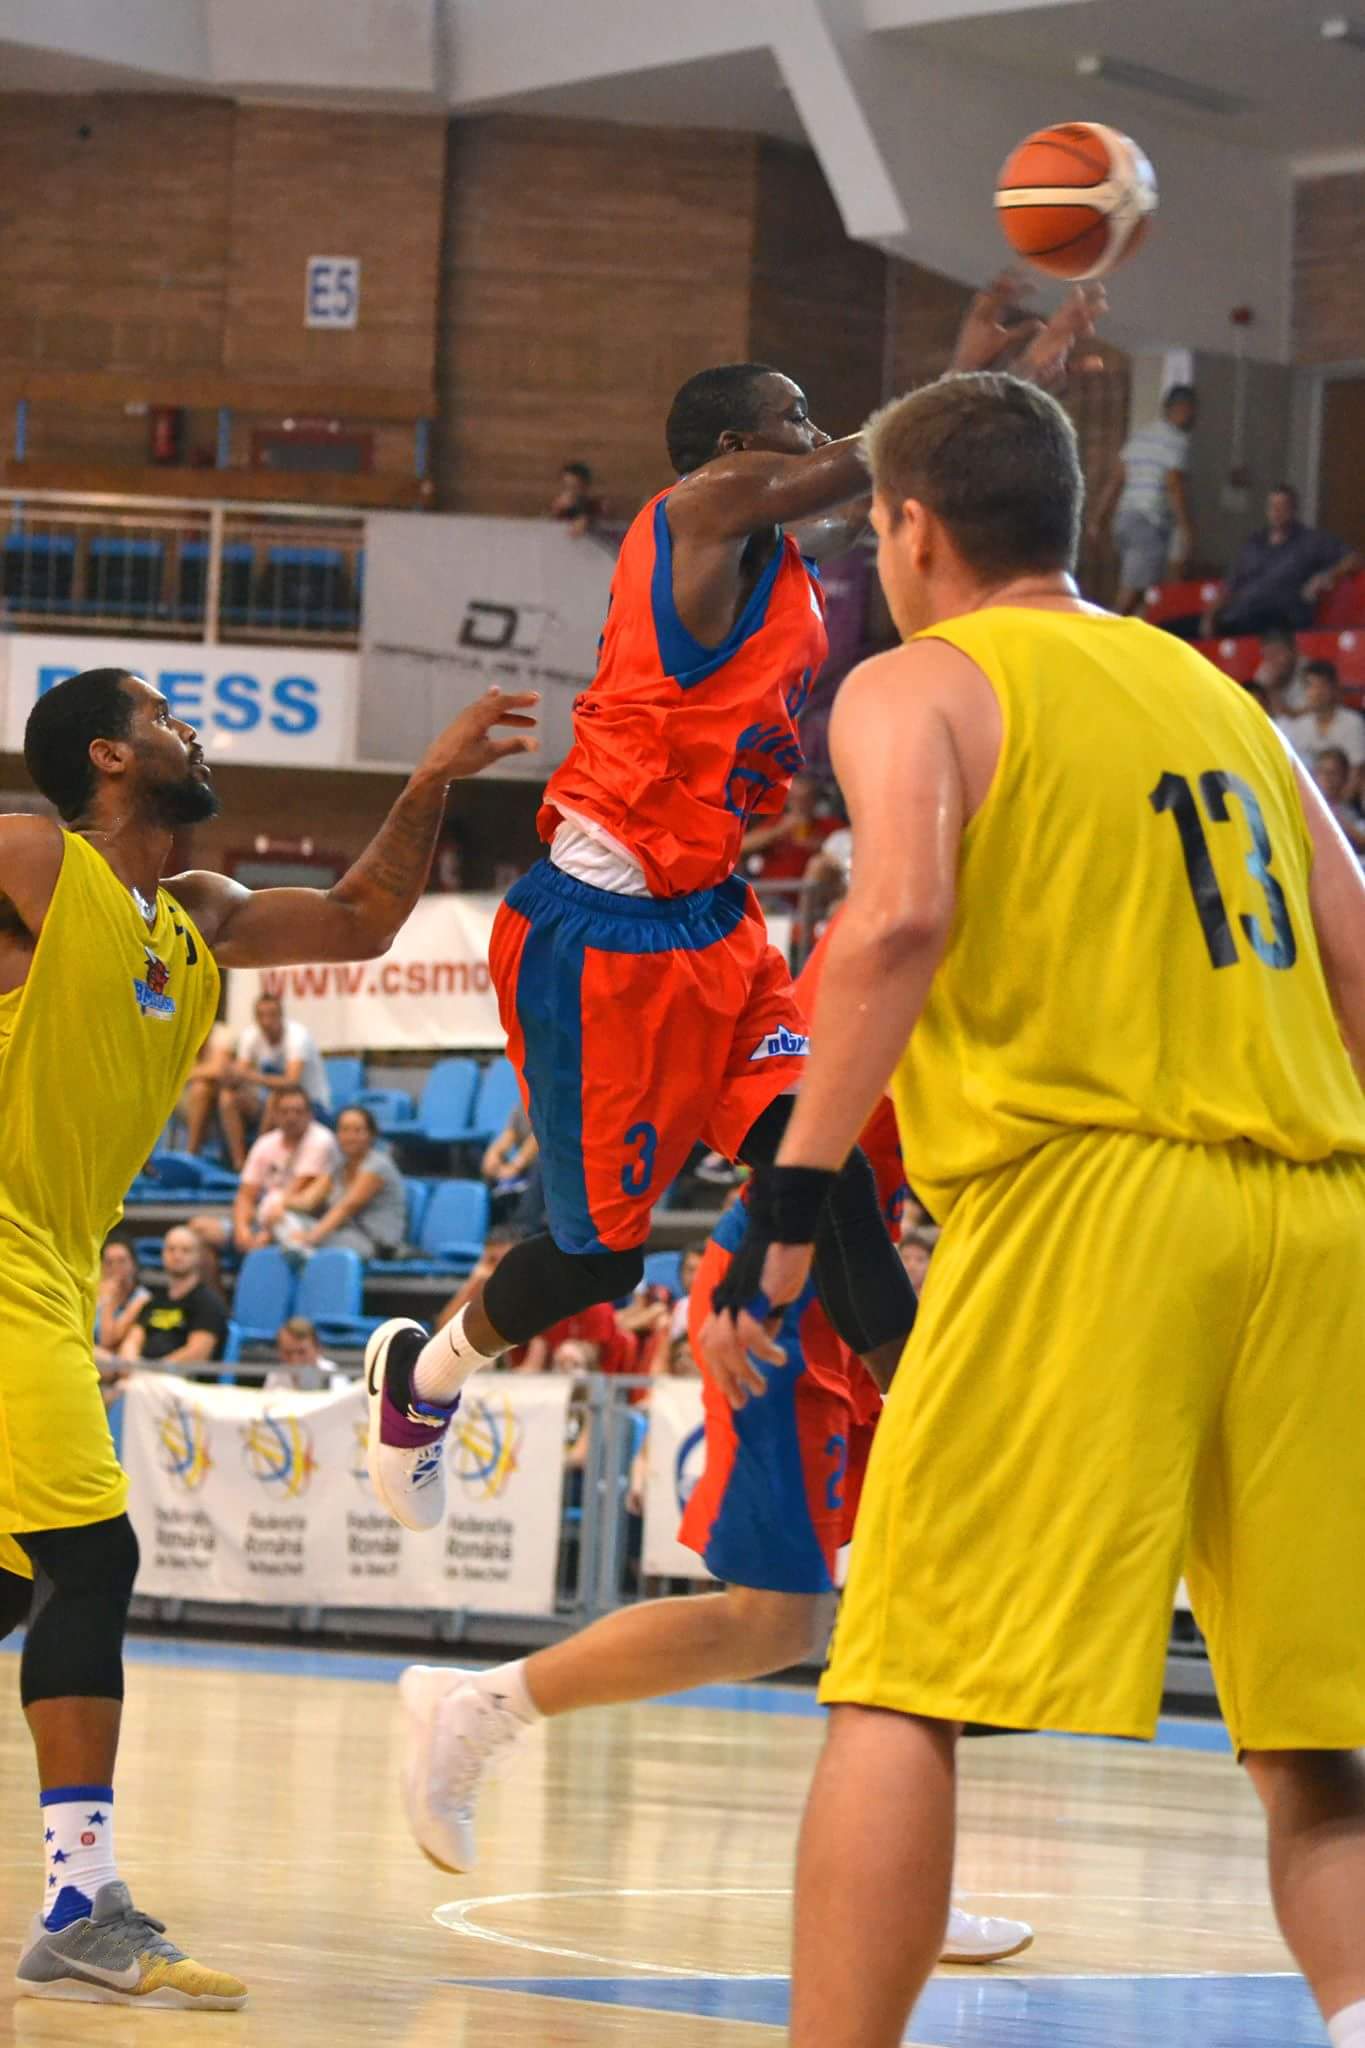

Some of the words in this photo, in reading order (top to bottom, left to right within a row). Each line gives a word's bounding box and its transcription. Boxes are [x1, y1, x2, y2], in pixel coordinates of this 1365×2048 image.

[311, 266, 353, 317] E5
[1148, 769, 1297, 970] 13
[622, 1121, 657, 1196] 3
